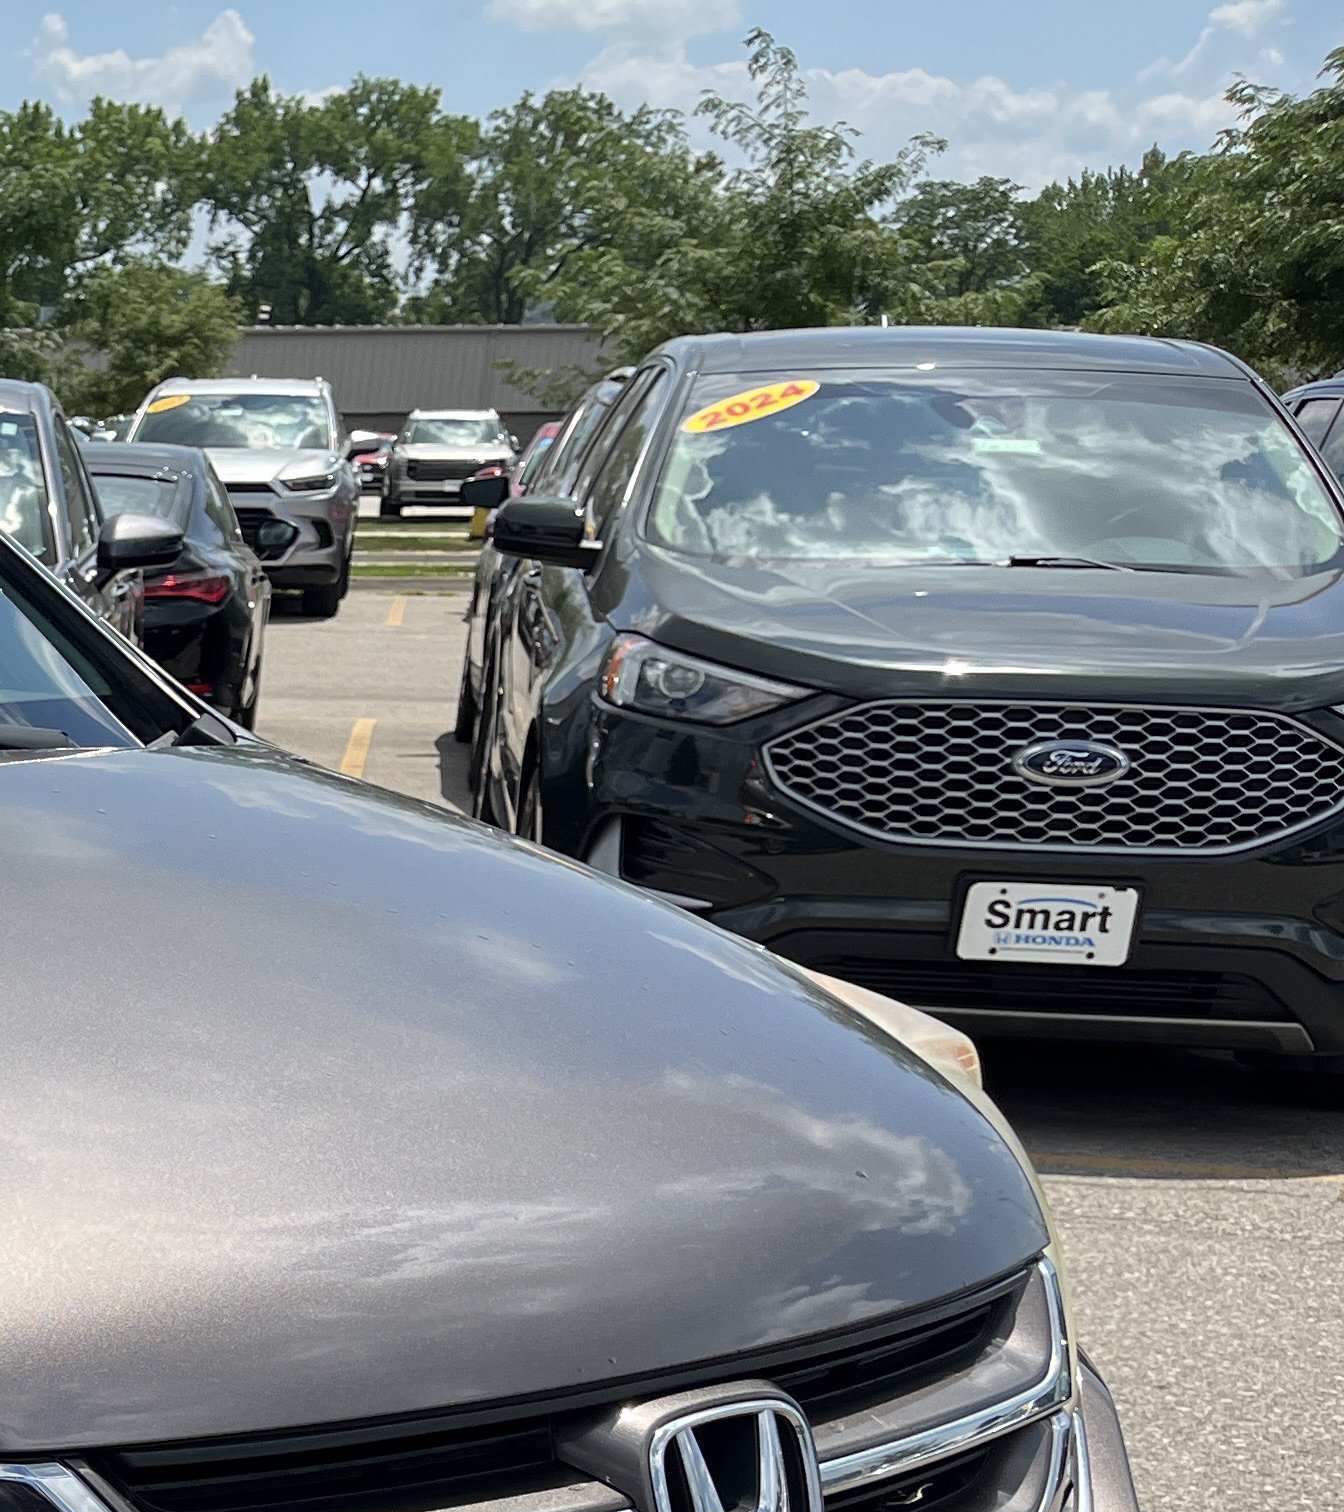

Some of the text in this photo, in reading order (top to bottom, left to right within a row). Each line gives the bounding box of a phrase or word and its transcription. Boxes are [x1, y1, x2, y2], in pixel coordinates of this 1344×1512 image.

[699, 383, 805, 427] 2024
[1042, 750, 1103, 775] Ford
[984, 899, 1113, 933] Smart
[1015, 933, 1095, 948] HONDA
